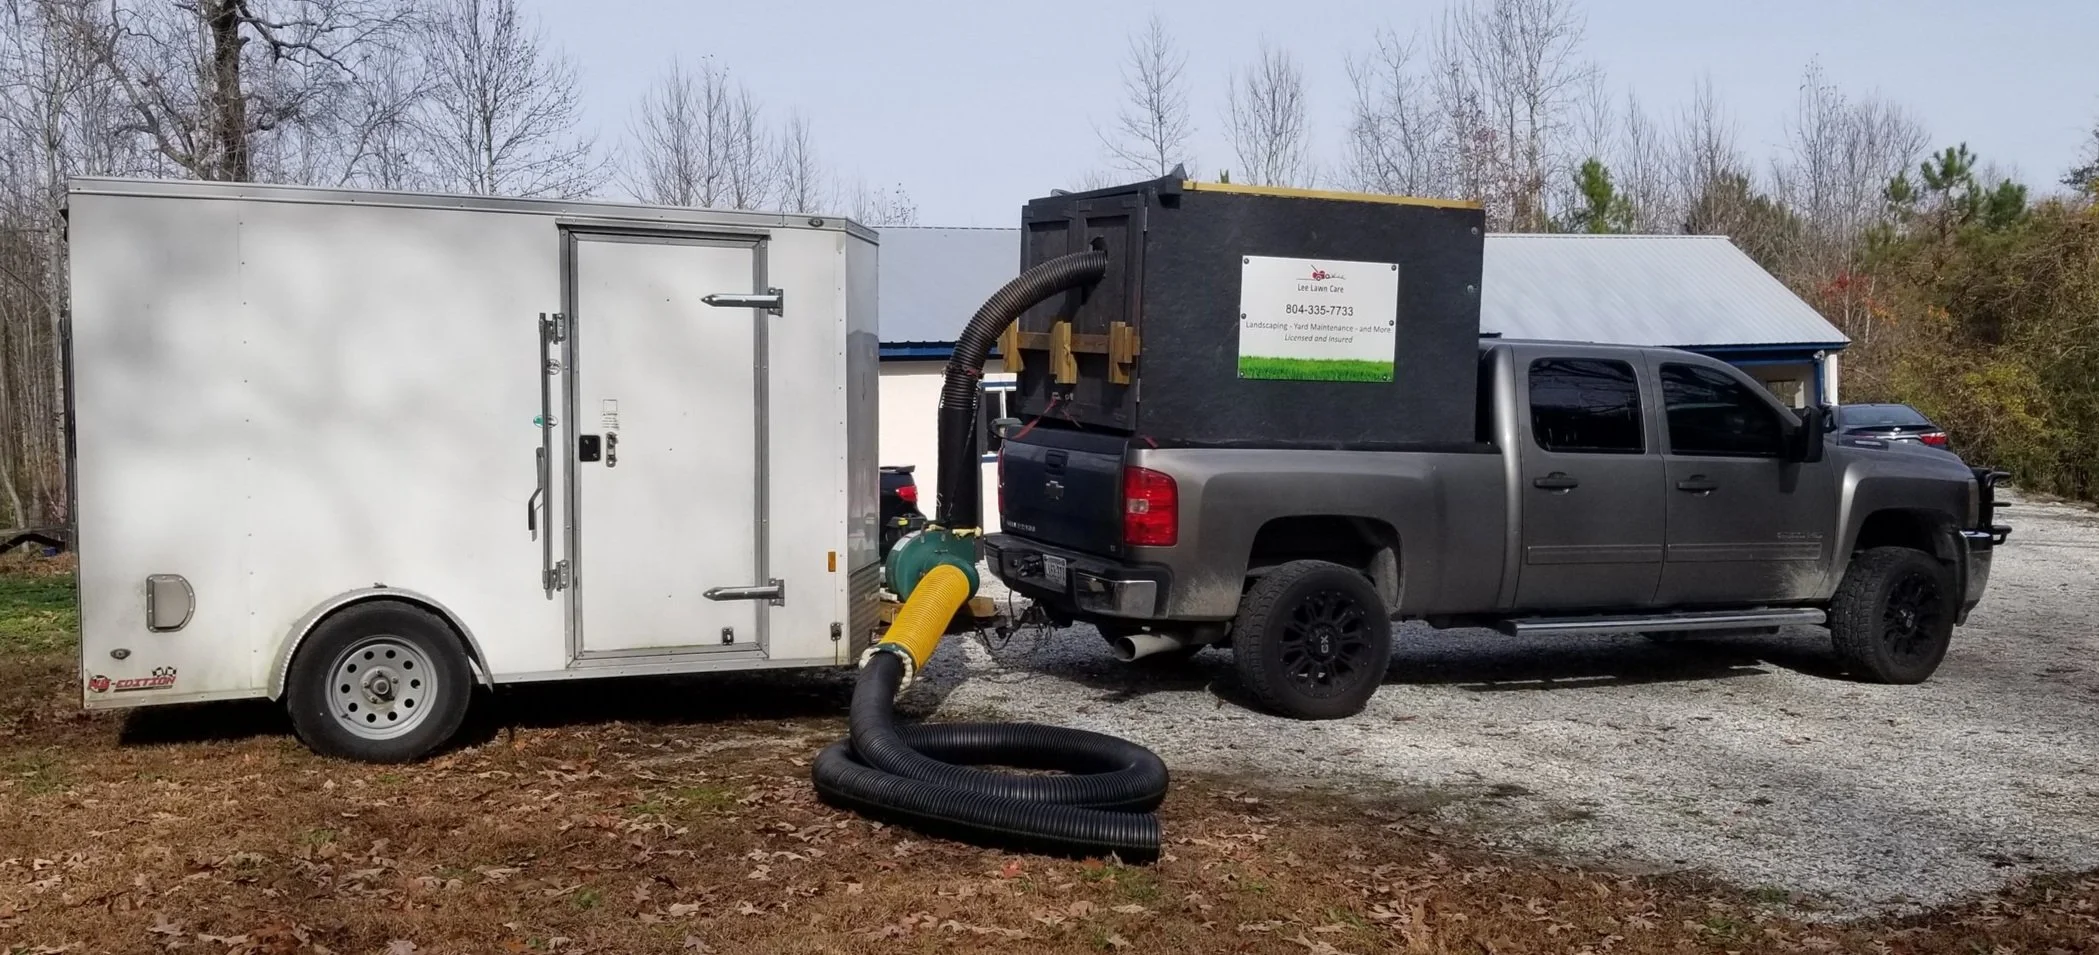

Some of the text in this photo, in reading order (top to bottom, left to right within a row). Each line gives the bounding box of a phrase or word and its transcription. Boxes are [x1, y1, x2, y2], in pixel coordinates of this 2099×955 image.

[1297, 283, 1344, 293] Lee Lawn Care
[1285, 303, 1354, 316] 804-335-7733
[1246, 321, 1288, 331] Landscaping
[1310, 323, 1353, 332] Maintenance
[1359, 325, 1372, 333] and
[1284, 334, 1313, 342] Licensed
[1314, 334, 1328, 342] and
